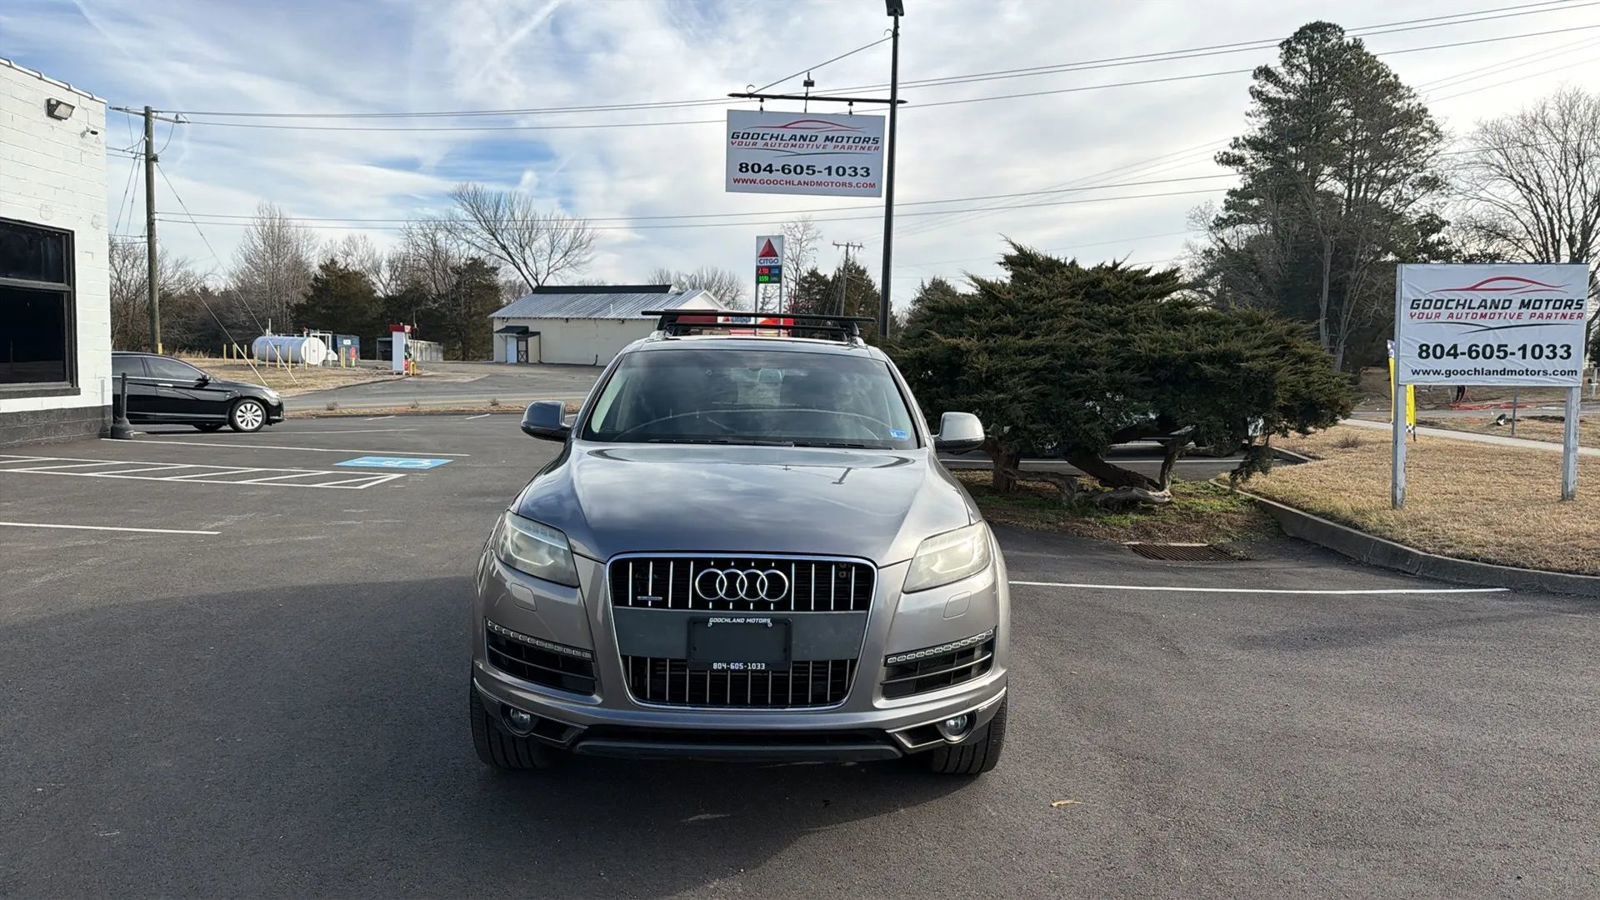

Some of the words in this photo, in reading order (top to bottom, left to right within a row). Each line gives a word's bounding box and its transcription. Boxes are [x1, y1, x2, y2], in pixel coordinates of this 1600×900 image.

[731, 131, 819, 143] GOOCHLAND
[823, 136, 880, 145] MOTORS
[762, 142, 828, 150] AUTOMOTIVE
[833, 144, 880, 152] PARTNER
[738, 162, 871, 178] 804-605-1033
[733, 177, 876, 189] WWW.GOOCHLANDMOTORS.COM
[1410, 299, 1512, 310] GOOCHLAND
[1518, 299, 1584, 310] MOTORS
[1409, 312, 1441, 320] YOUR
[1447, 312, 1523, 320] AUTOMOTIVE
[1529, 312, 1584, 320] PARTNER
[1417, 343, 1572, 360] 804-605-1033
[1411, 367, 1578, 378] www.goochlandmotors.com
[712, 662, 766, 670] 804-605-1033
